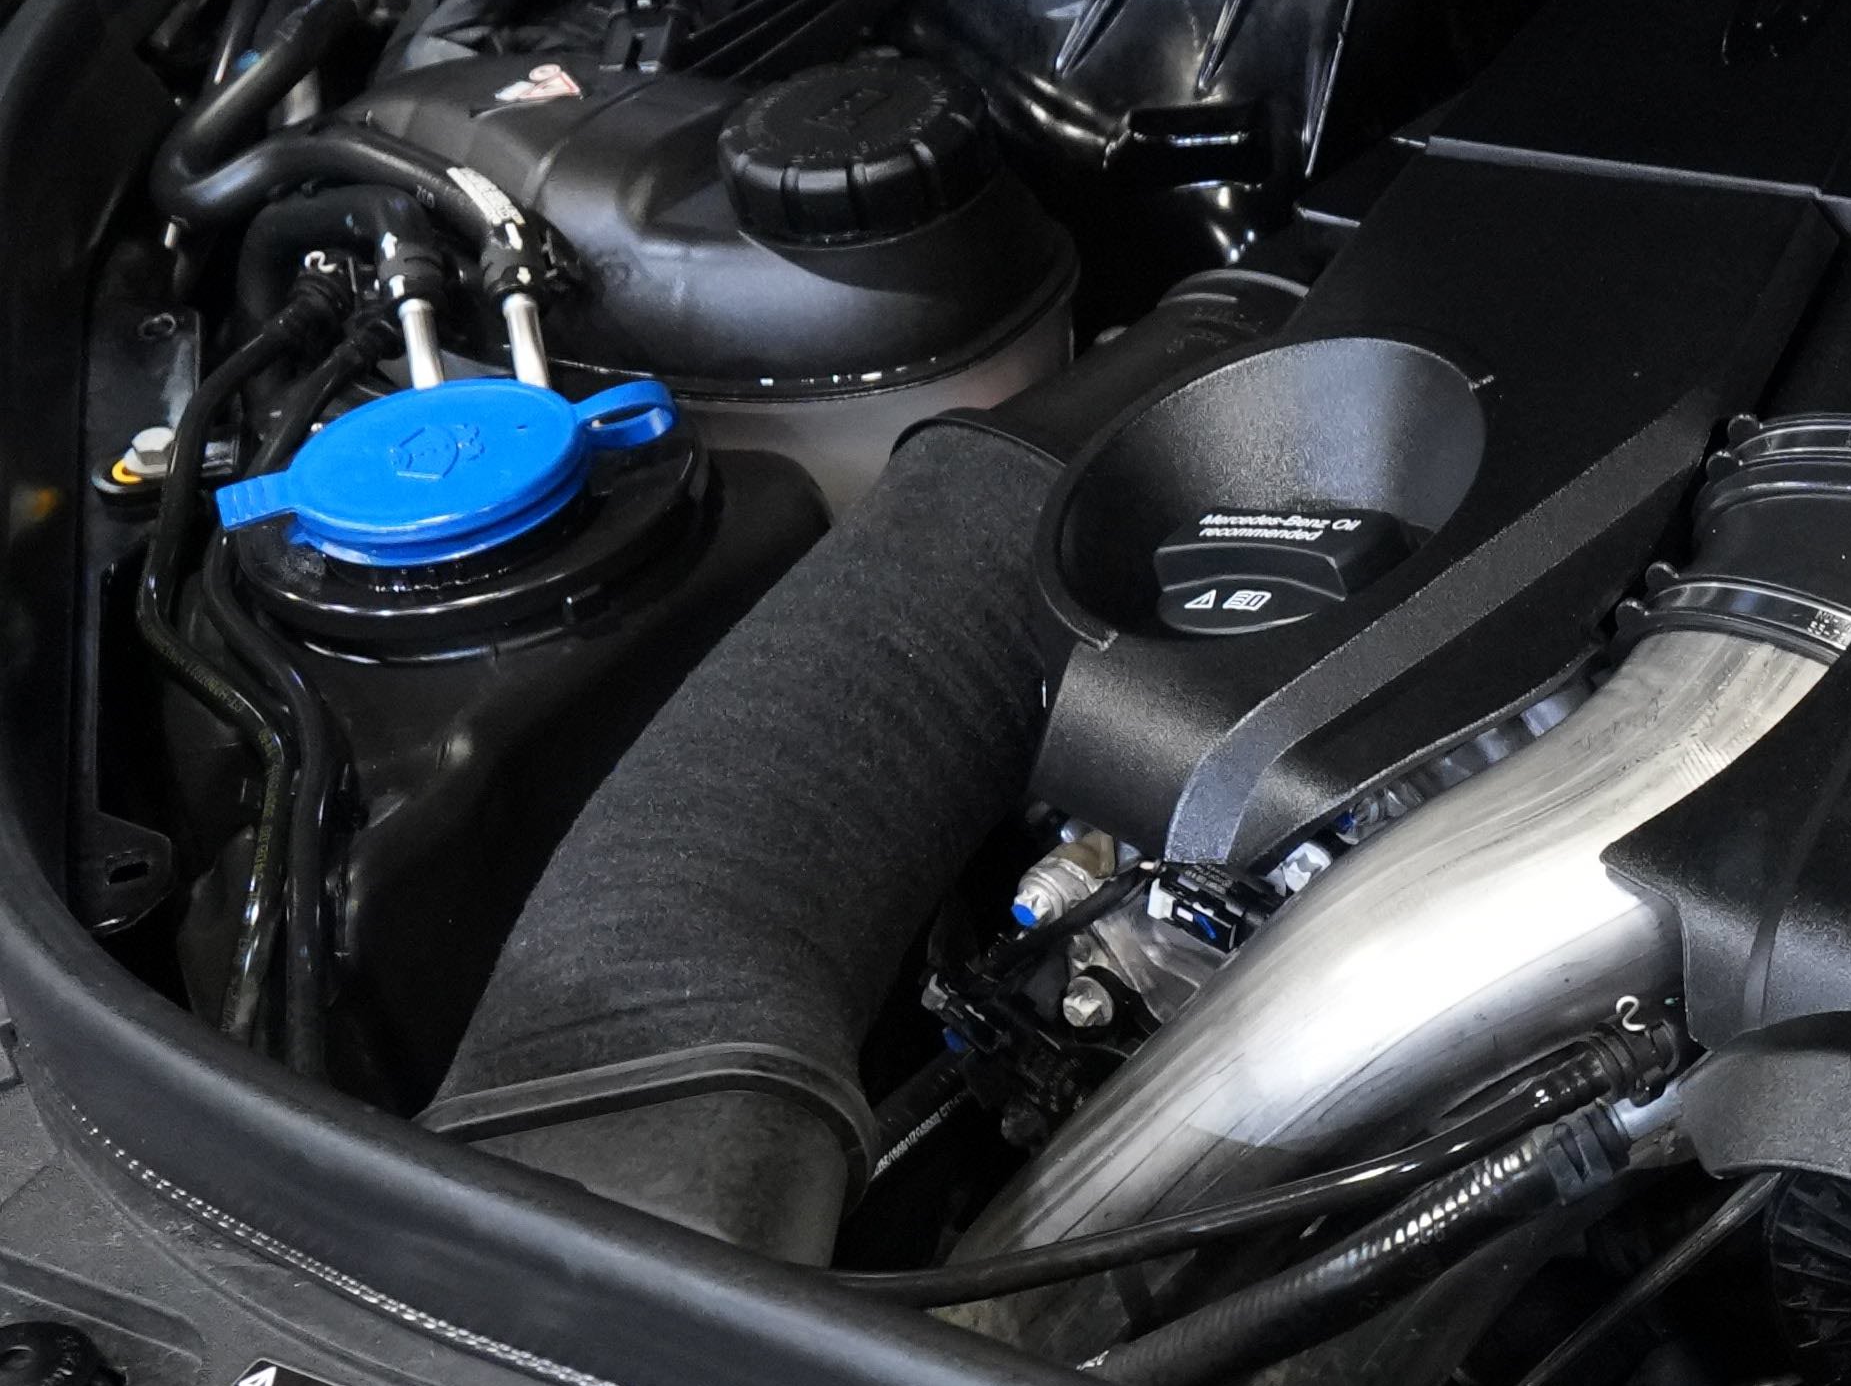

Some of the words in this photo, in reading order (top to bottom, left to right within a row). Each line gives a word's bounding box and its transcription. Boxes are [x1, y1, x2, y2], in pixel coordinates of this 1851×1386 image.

[1199, 514, 1331, 529] Mercedes-Benz
[1332, 518, 1362, 532] Oil
[1199, 527, 1323, 541] recommended
